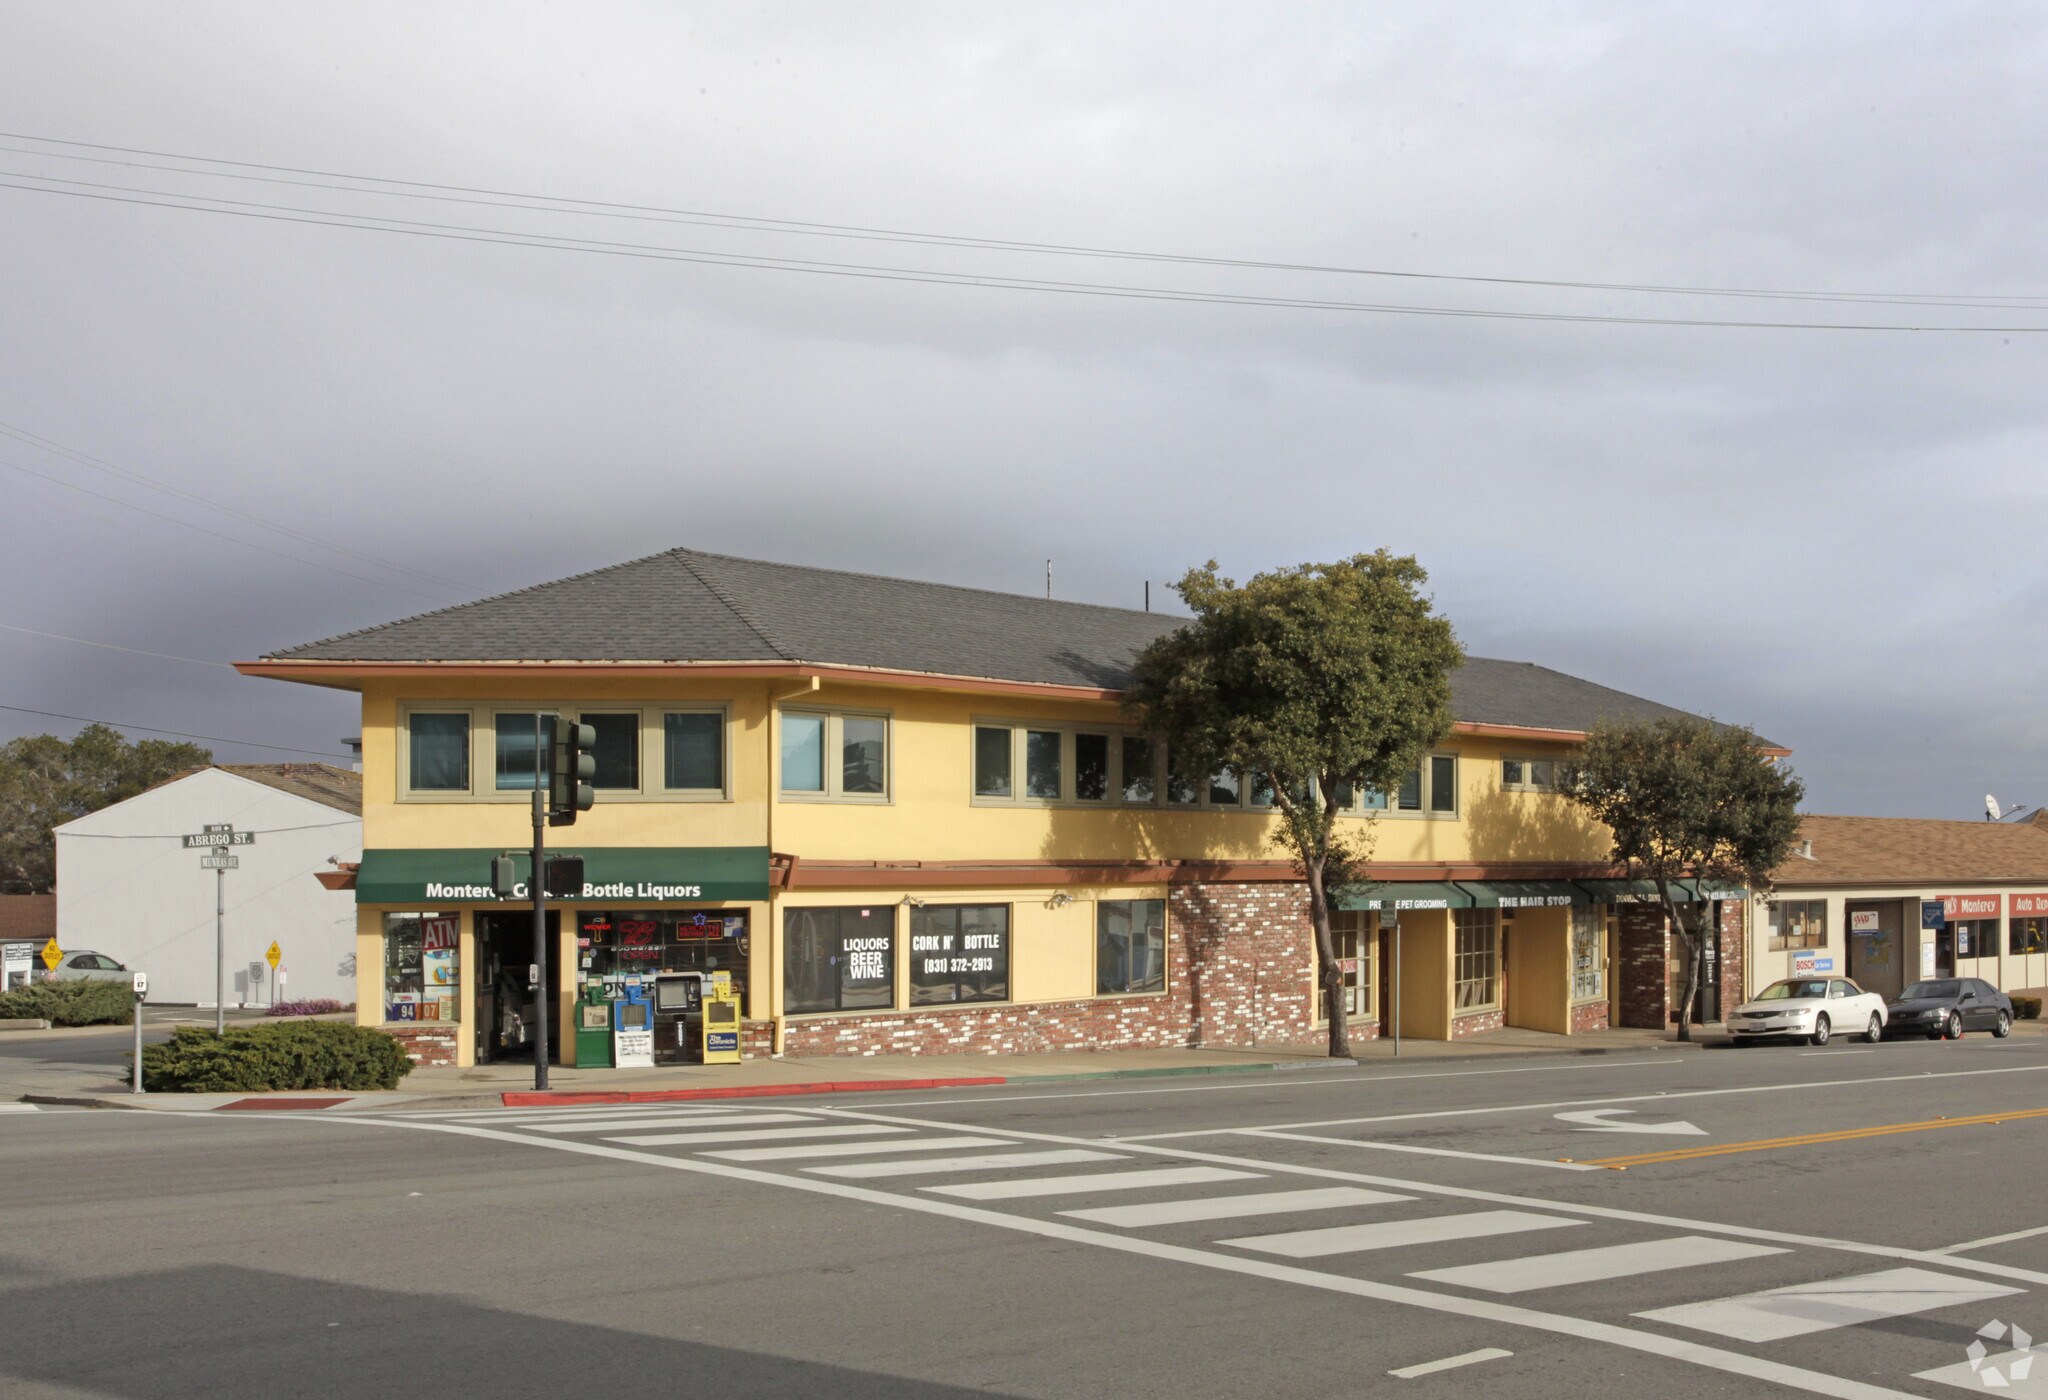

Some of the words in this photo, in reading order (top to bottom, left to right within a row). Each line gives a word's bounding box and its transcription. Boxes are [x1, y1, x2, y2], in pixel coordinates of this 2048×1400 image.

[188, 833, 230, 846] ABREGO
[234, 833, 250, 844] ST.
[582, 882, 634, 898] Bottle
[637, 883, 701, 901] Liquors
[1401, 900, 1414, 909] PET
[1414, 899, 1448, 908] GROOMING
[1498, 897, 1518, 907] THE
[1520, 896, 1544, 907] HAIR
[1547, 895, 1571, 906] STOP
[1962, 899, 1996, 913] Monterey
[2016, 897, 2033, 911] Auto
[425, 919, 460, 948] ATM
[844, 938, 889, 952] LIQUORS
[912, 935, 940, 951] CORK
[943, 935, 954, 950] N'
[964, 934, 1000, 950] BOTTLE
[623, 950, 658, 960] OPEN
[850, 952, 883, 966] BEER
[850, 965, 884, 979] WINE
[924, 958, 948, 974] (831)
[950, 957, 993, 972] 372-2913
[1796, 960, 1815, 970] BOSCH
[401, 1005, 414, 1017] 94
[424, 1005, 436, 1017] 07
